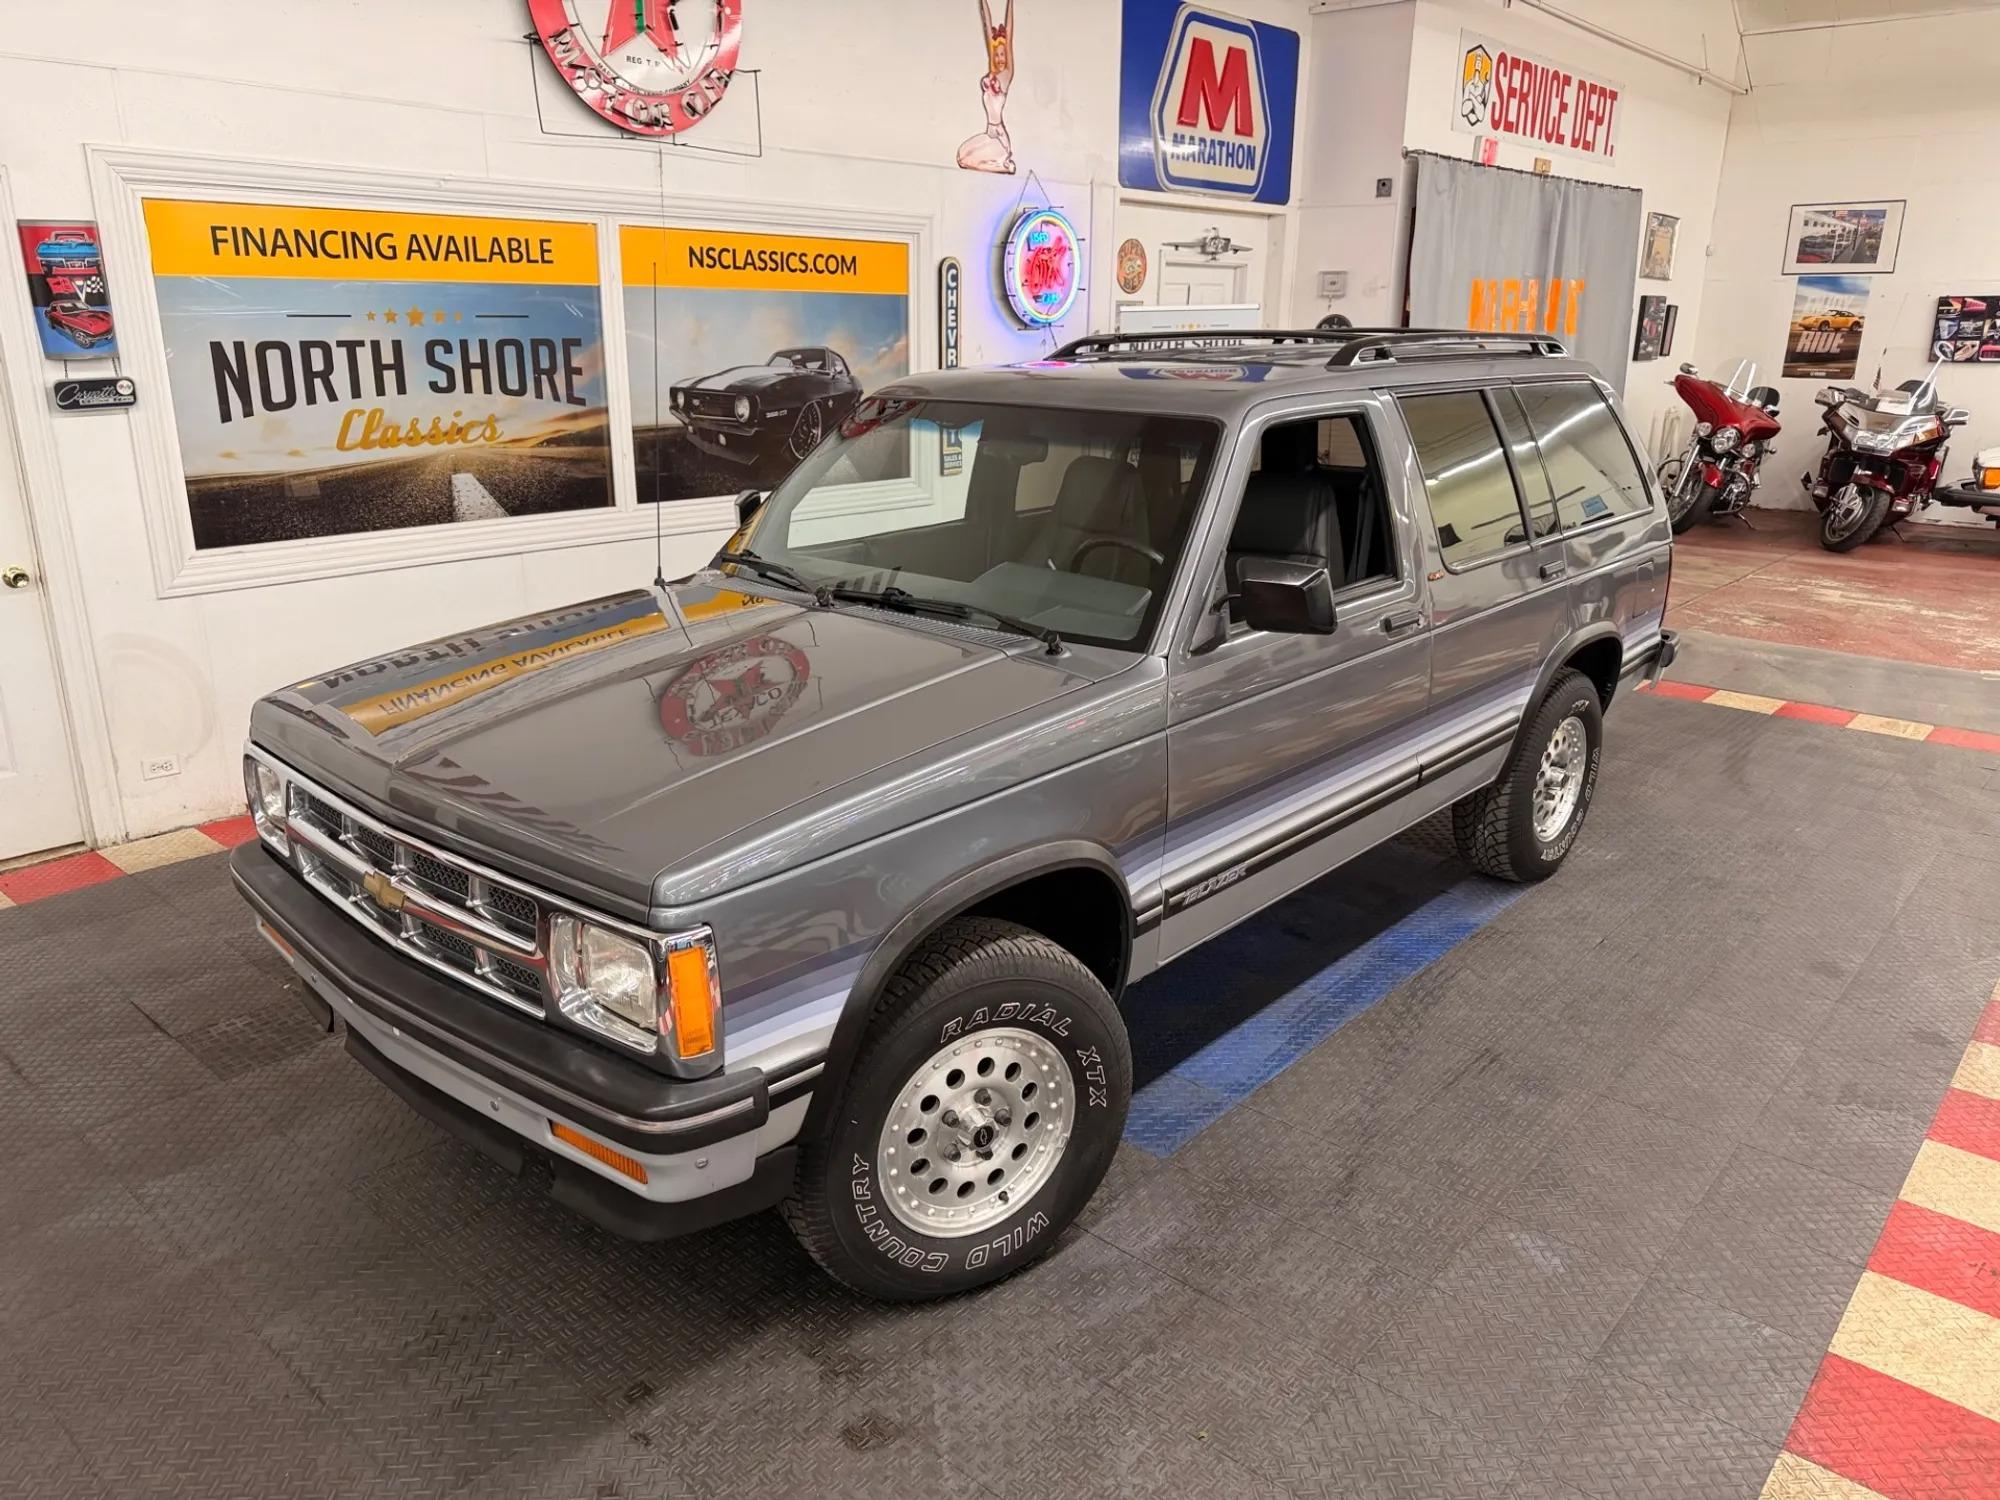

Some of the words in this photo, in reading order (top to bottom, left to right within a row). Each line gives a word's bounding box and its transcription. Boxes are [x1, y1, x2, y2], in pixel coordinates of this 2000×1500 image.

[548, 28, 674, 131] MOTOR
[1176, 36, 1255, 138] M
[1490, 51, 1572, 147] SERVICE
[1570, 79, 1619, 158] DEPT.
[1170, 132, 1257, 173] MARATHON
[210, 225, 398, 261] FINANCING
[405, 233, 555, 265] AVAILABLE
[688, 245, 858, 276] NSCLASSICS.COM
[1795, 330, 1845, 354] RIDE
[57, 383, 118, 406] Corvette
[209, 338, 408, 424] NORTH
[424, 337, 587, 406] SHORE
[335, 408, 503, 453] Classics
[1182, 862, 1248, 907] BLAZER
[940, 1002, 1072, 1044] RADIAL
[1076, 1045, 1108, 1108] XTX
[852, 1153, 950, 1273] COUNTRY
[964, 1211, 1050, 1270] WILD
